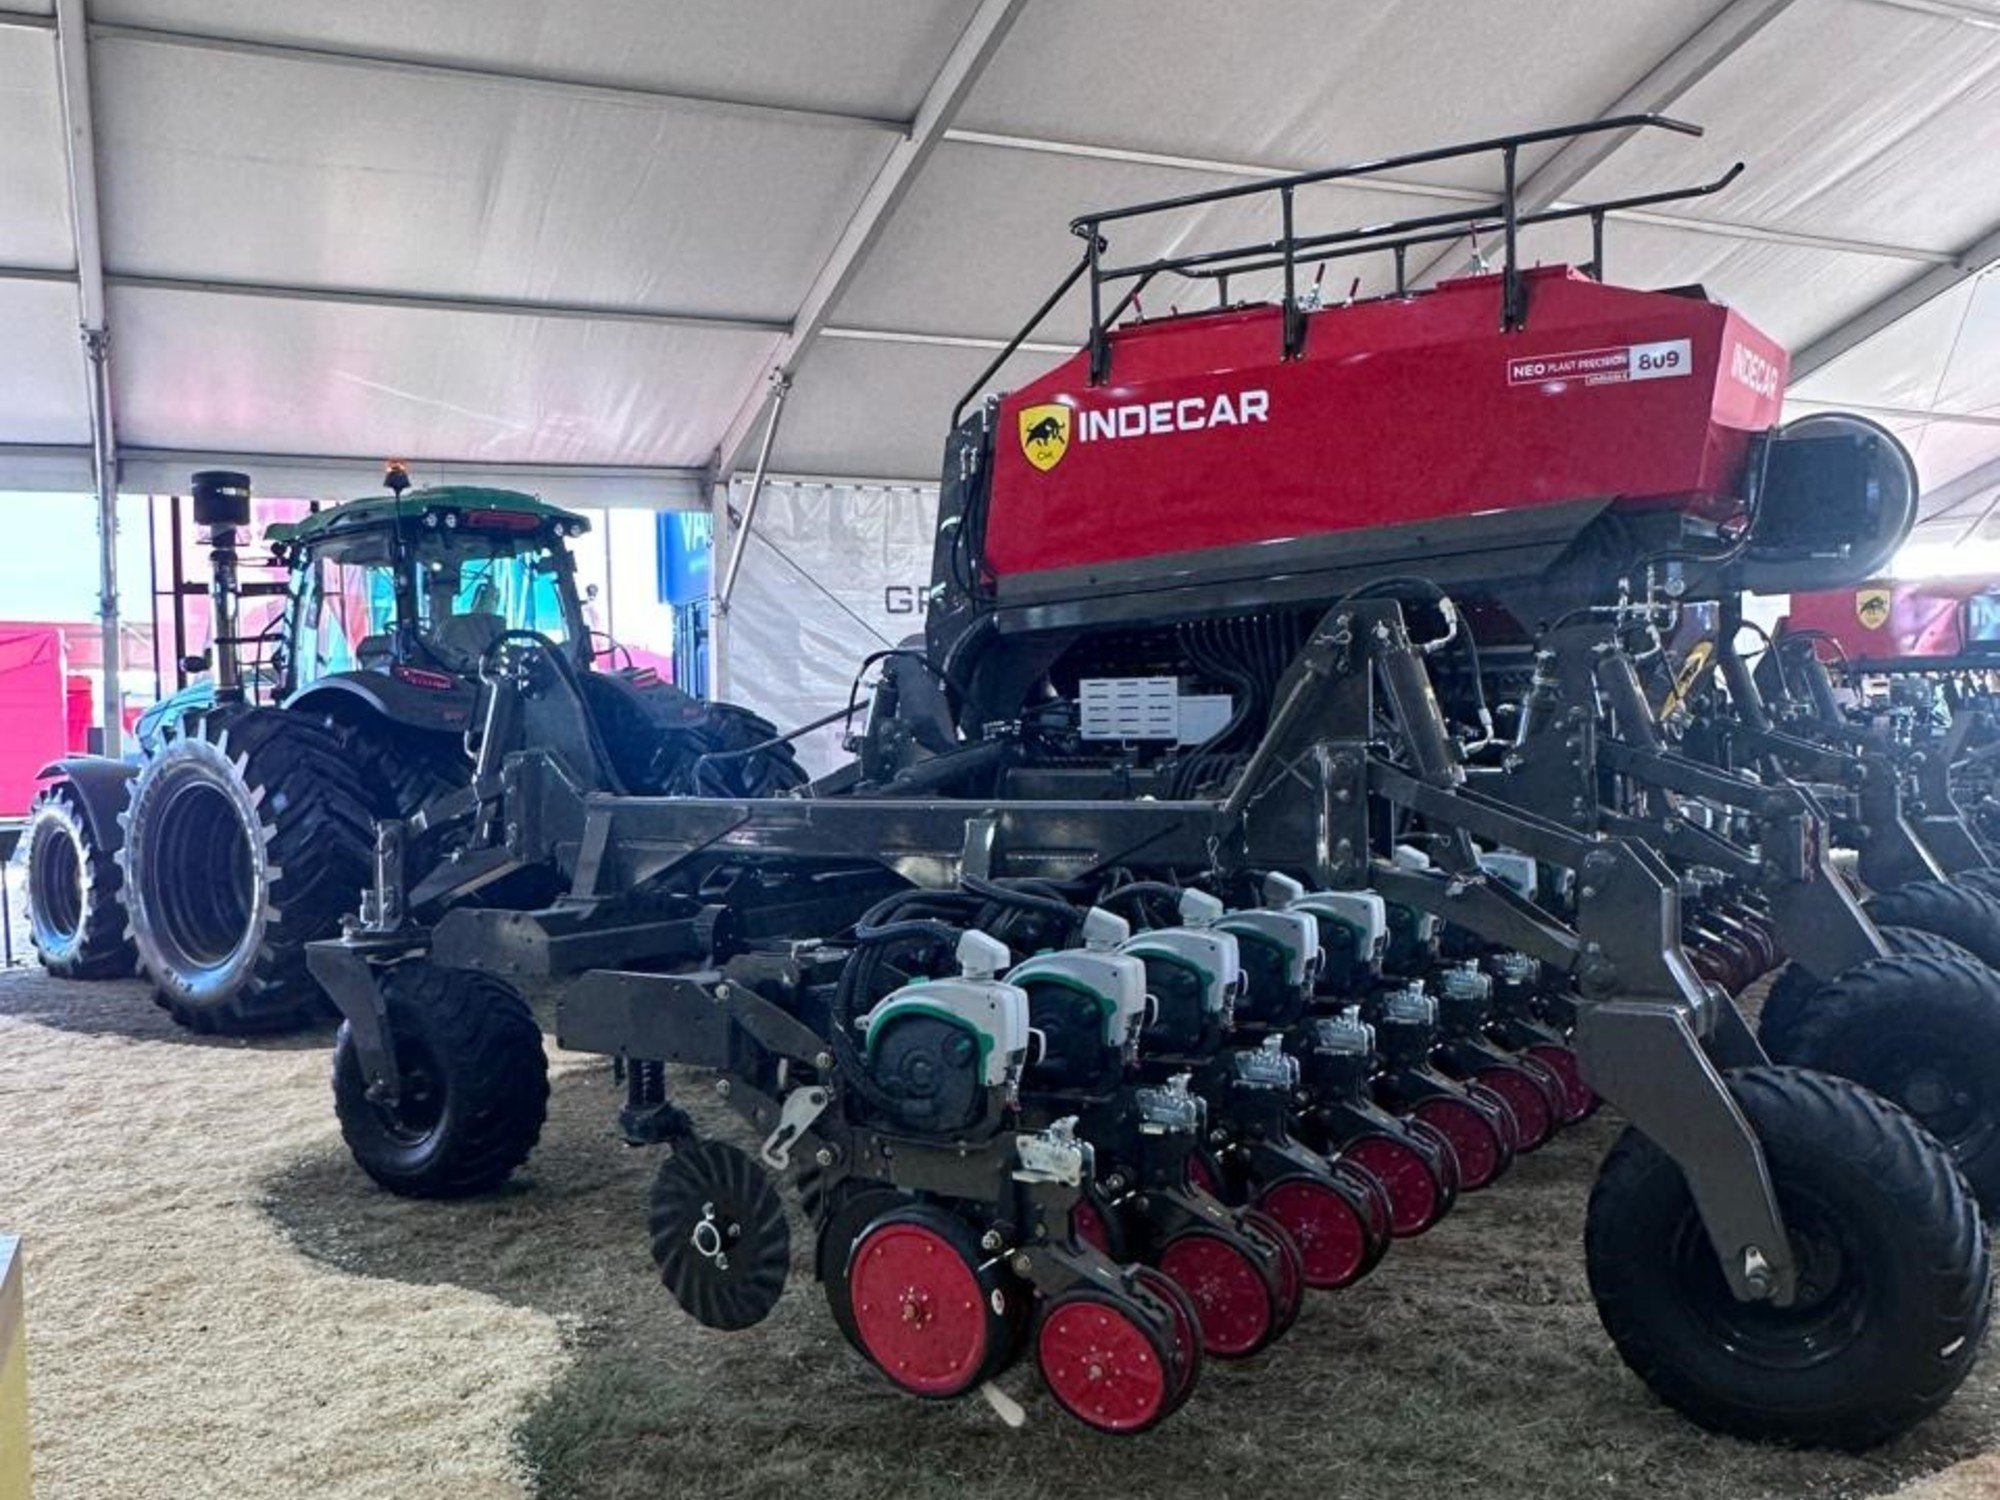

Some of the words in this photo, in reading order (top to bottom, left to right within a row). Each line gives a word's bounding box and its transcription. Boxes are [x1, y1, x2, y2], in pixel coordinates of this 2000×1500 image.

[1513, 362, 1545, 378] NEO
[1638, 348, 1680, 370] 809
[1079, 389, 1270, 443] INDECAR
